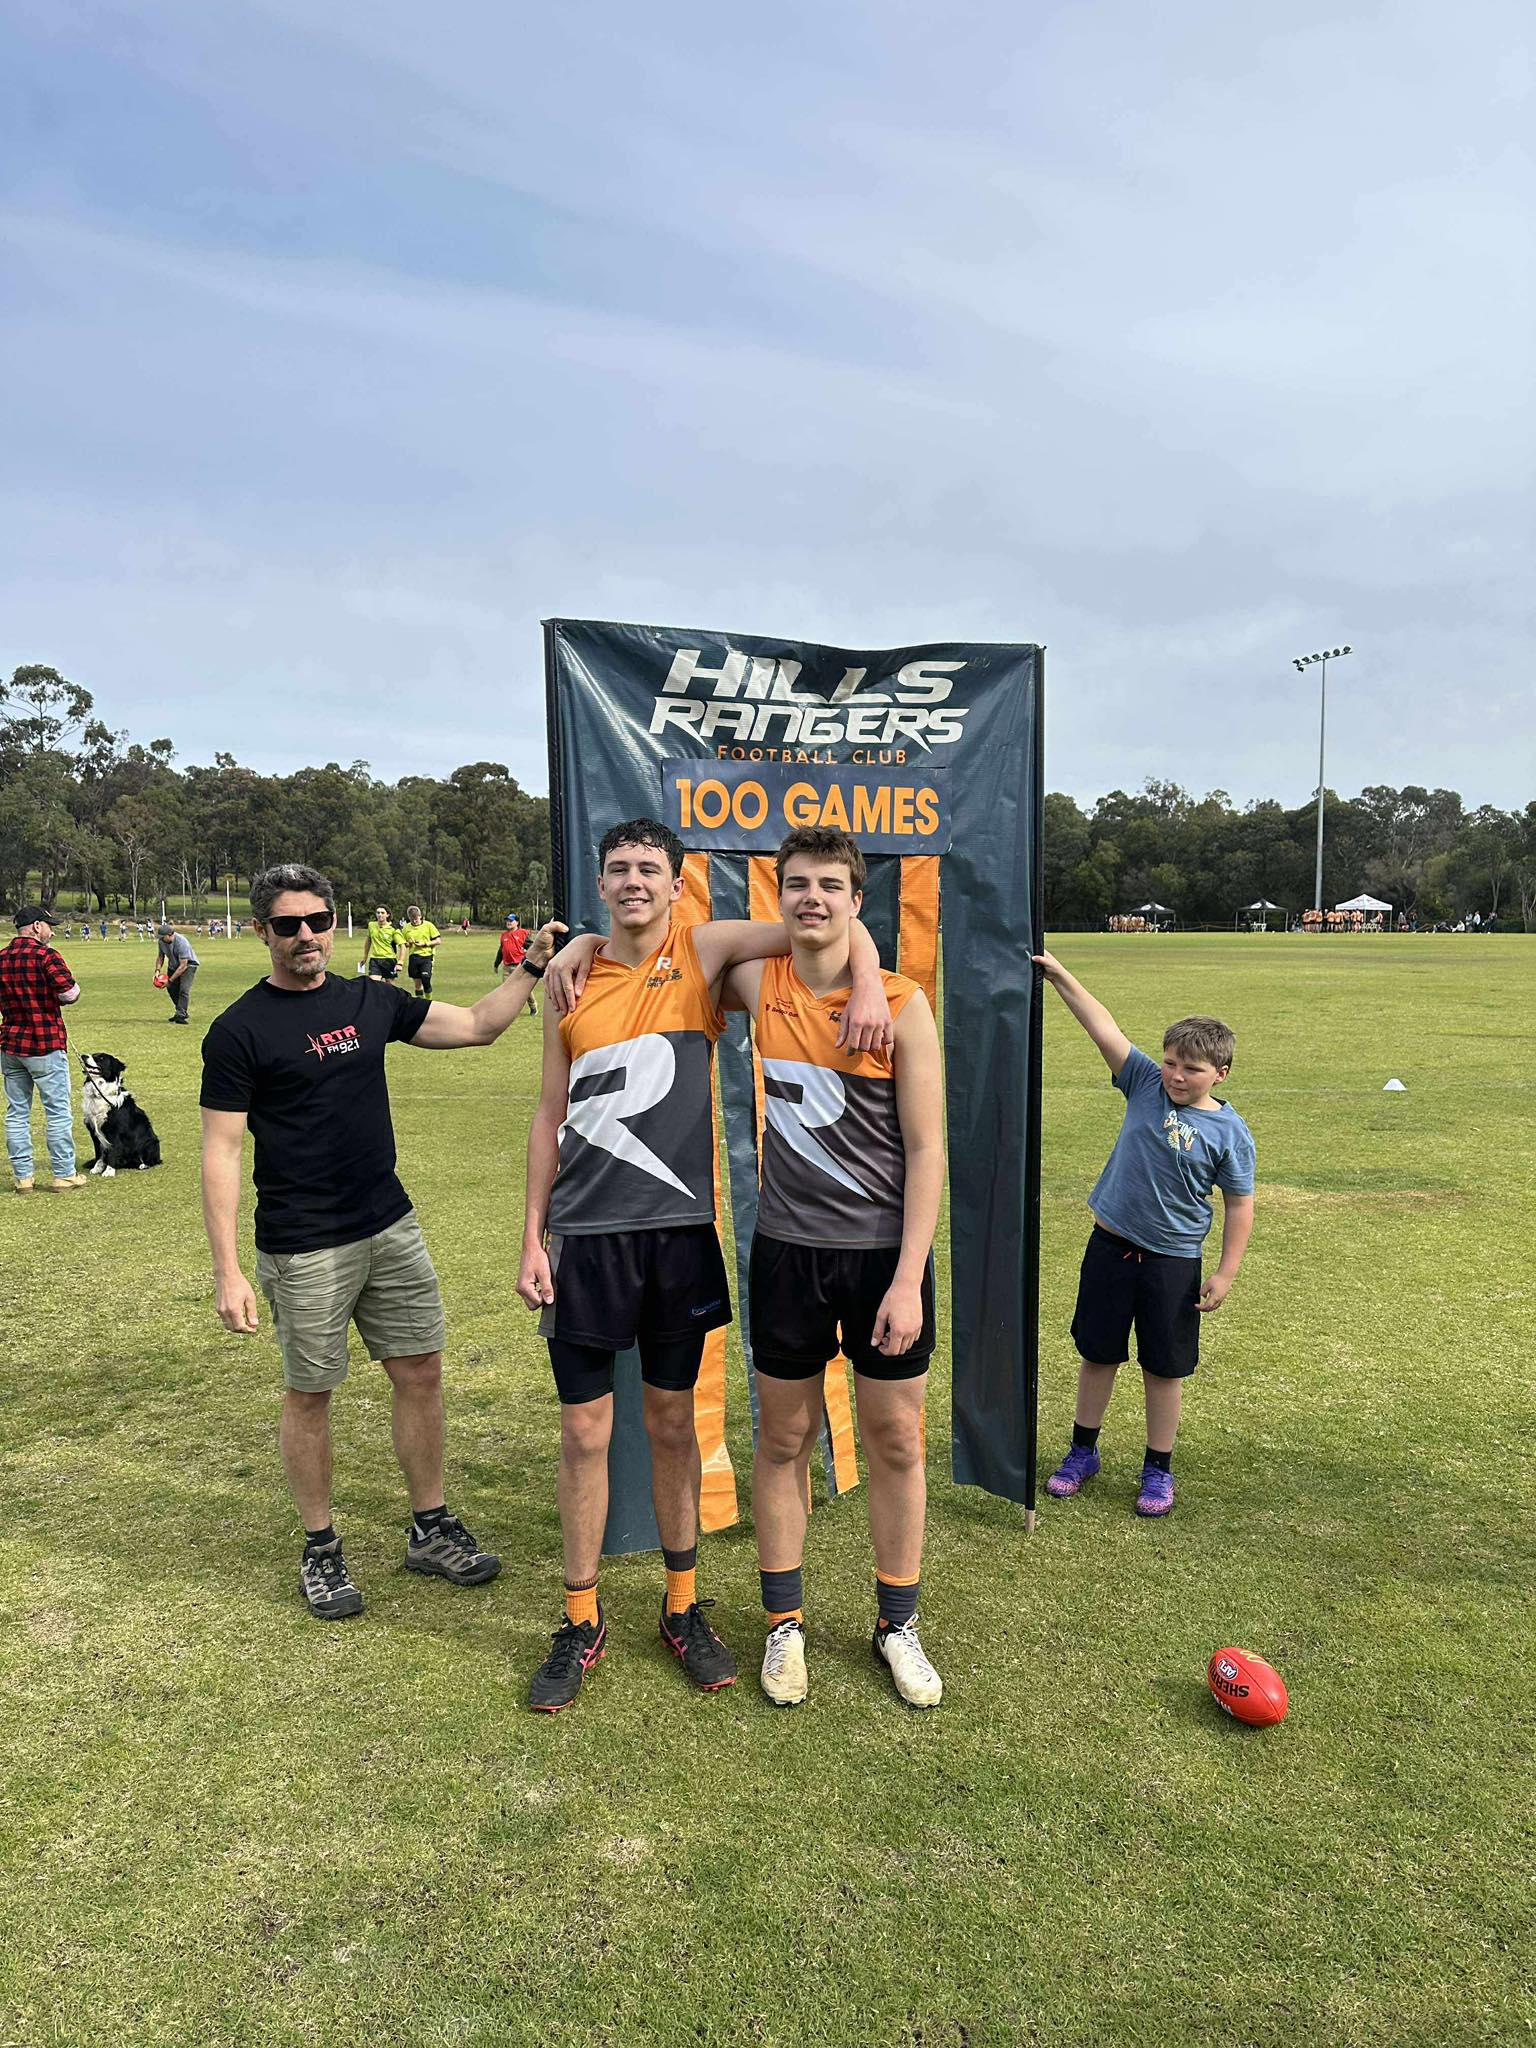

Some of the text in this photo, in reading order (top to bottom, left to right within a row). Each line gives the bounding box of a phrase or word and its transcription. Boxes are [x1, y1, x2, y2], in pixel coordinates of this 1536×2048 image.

[661, 648, 968, 704] HILLS
[649, 697, 970, 754] RANGERS
[717, 745, 907, 764] FOOTBALL CLUB
[675, 778, 940, 835] 100 GAMES
[320, 1025, 357, 1045] RTR
[327, 1038, 360, 1054] FM 92.1
